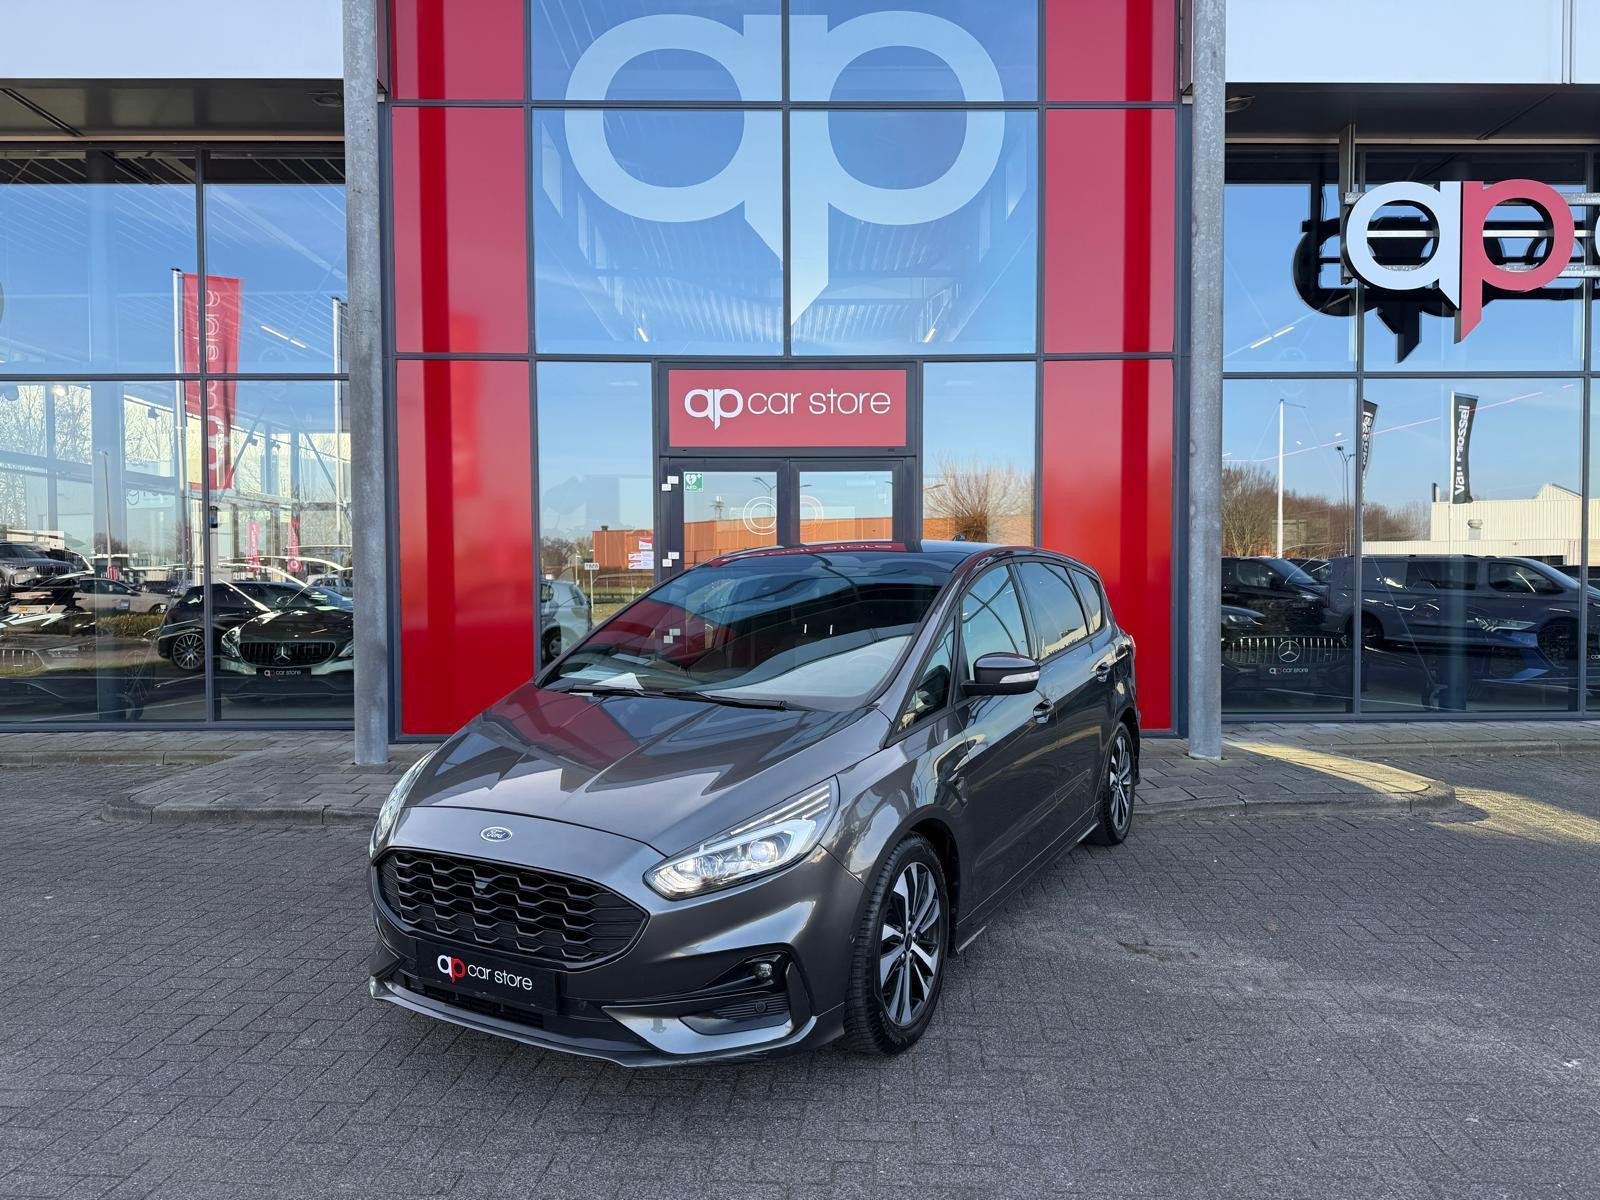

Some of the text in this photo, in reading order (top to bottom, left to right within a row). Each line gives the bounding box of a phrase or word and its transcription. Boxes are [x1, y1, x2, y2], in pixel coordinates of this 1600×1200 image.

[564, 10, 1005, 327] ap
[1345, 178, 1575, 343] ap
[684, 387, 891, 430] ap car store
[437, 954, 533, 991] ap car store
